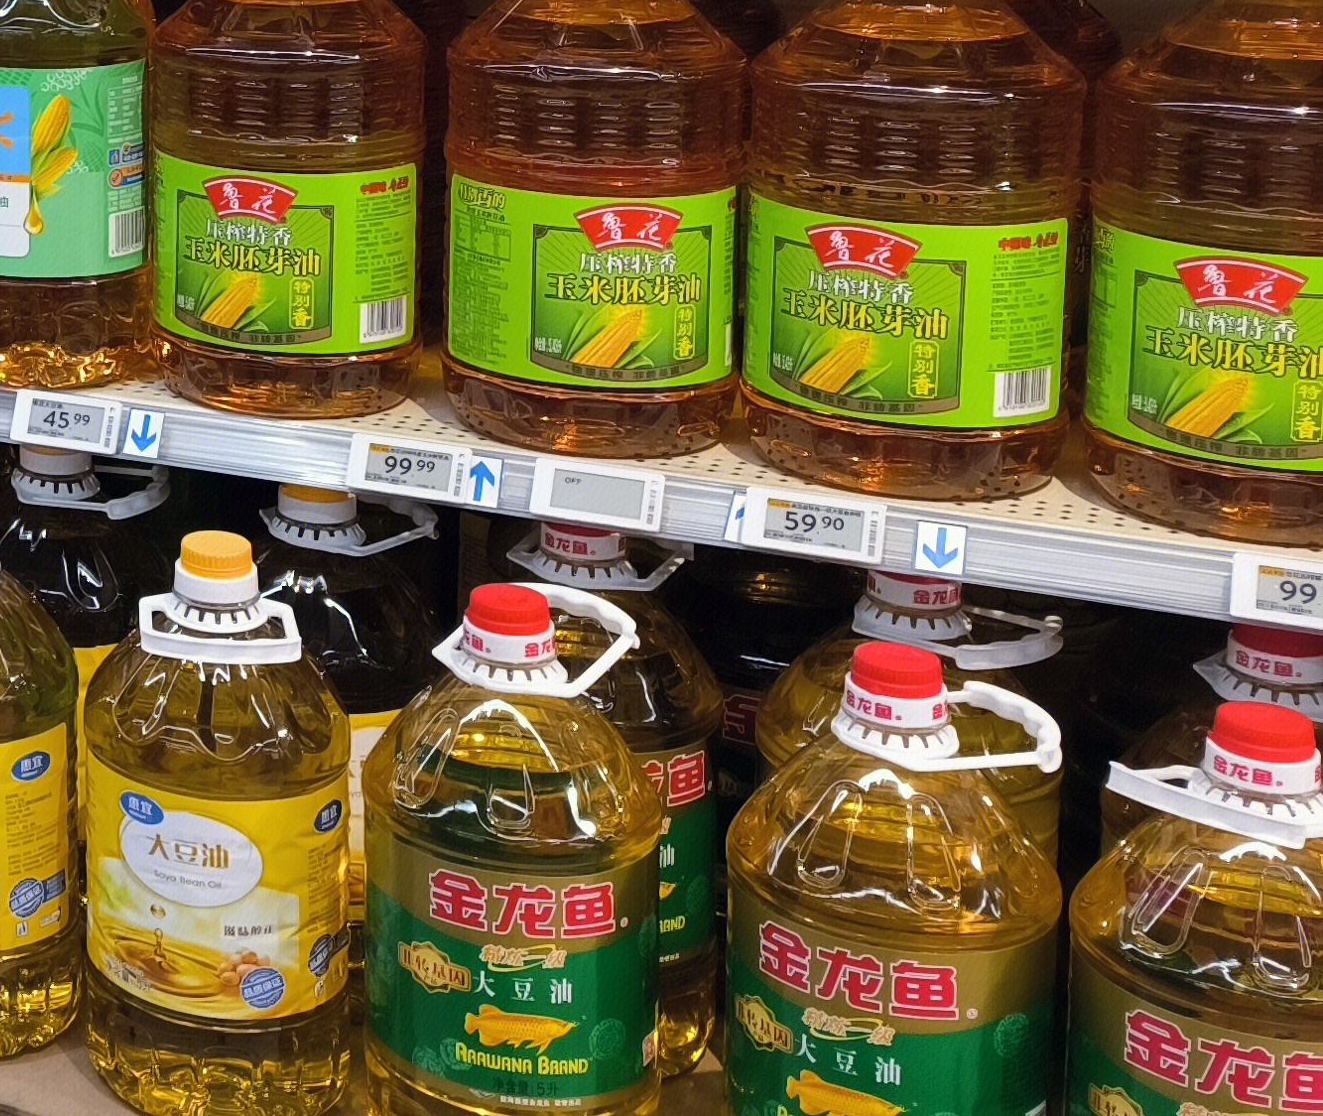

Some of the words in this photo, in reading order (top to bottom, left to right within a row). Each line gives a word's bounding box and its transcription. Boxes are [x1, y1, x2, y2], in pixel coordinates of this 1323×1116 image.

[220, 183, 277, 213] 鲁花
[206, 219, 292, 246] 压榨特香
[597, 215, 665, 247] 鲁花
[828, 231, 895, 268] 鲁花
[184, 236, 321, 277] 玉米胚芽油
[579, 253, 678, 275] 压榨特香
[293, 280, 311, 328] 特别香
[546, 274, 701, 306] 玉米胚芽油
[808, 269, 914, 304] 压榨特香
[1197, 265, 1288, 308] 鲁花
[781, 287, 949, 340] 玉米胚芽油
[1177, 306, 1299, 344] 压榨特香
[676, 307, 694, 358] 特别香
[912, 342, 935, 397] 特别香
[1297, 382, 1321, 439] 特别香
[1235, 649, 1296, 676] 金龙鱼
[845, 689, 894, 720] 金龙鱼
[1213, 754, 1273, 786] 金龙鱼
[148, 832, 230, 870] 大豆油
[429, 869, 616, 939] 金龙鱼
[472, 971, 573, 1004] 大豆油
[759, 920, 958, 1020] 金龙鱼
[455, 1043, 532, 1074] ARAWANA
[538, 1056, 589, 1074] BRAND
[793, 1033, 901, 1085] 大豆油
